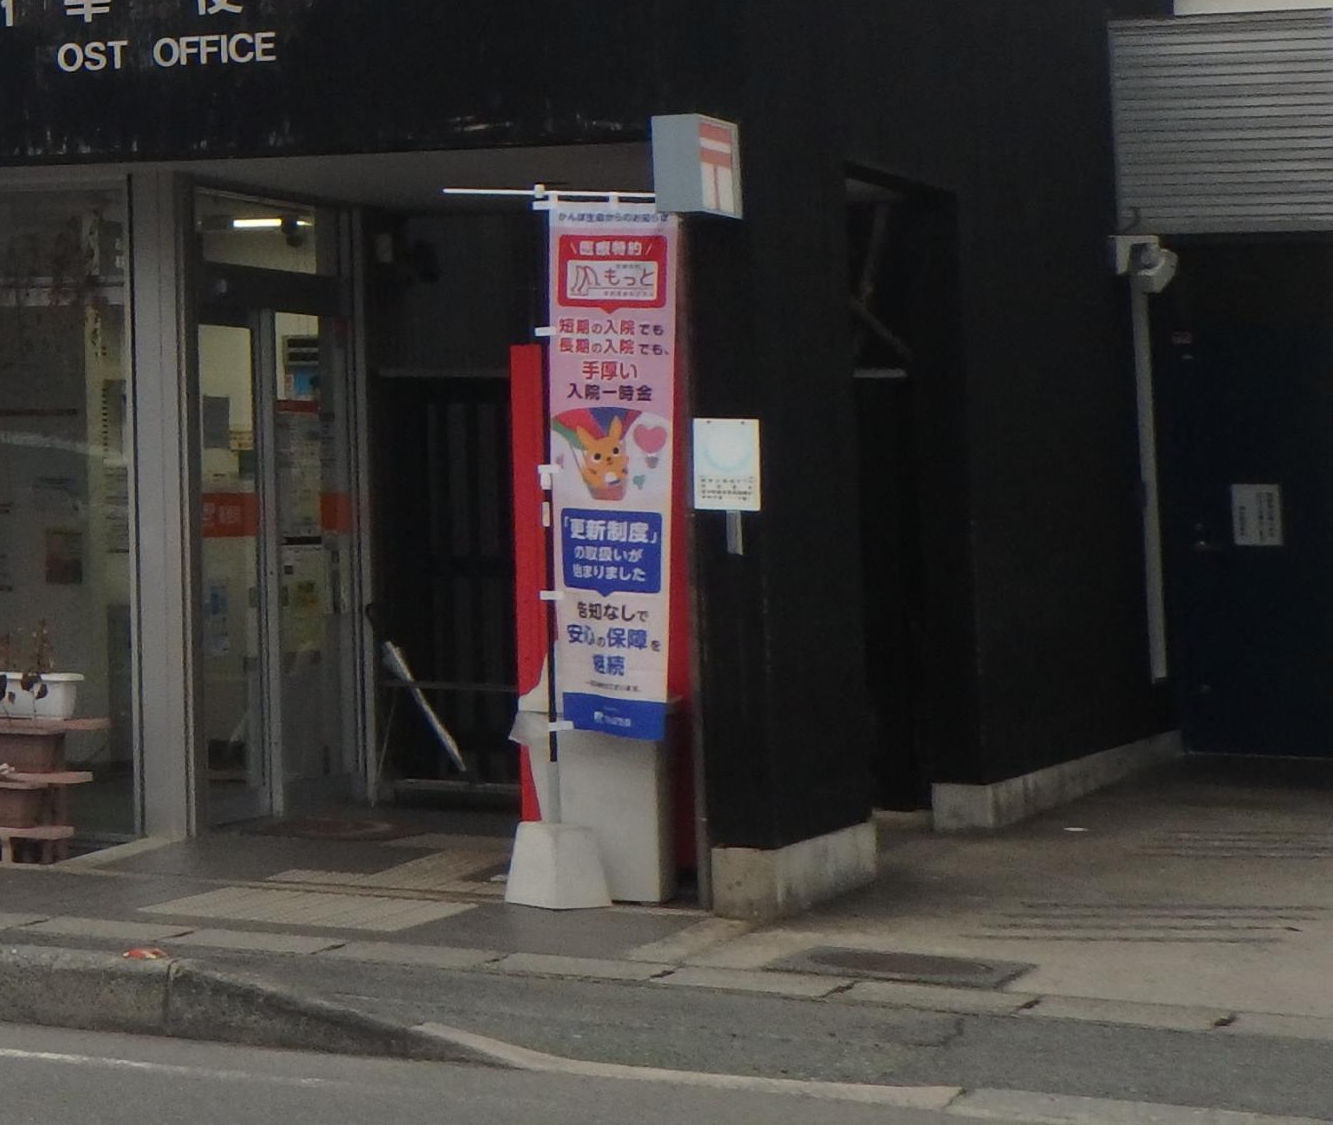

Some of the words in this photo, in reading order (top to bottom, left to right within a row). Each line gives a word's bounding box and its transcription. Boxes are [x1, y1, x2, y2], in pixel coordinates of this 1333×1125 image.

[153, 31, 277, 68] OFFICE
[605, 267, 654, 286] もっと
[582, 360, 638, 381] 手厚い
[567, 382, 652, 402] 入院一時金
[576, 601, 649, 623] 告知なしで
[566, 624, 661, 652] 安心の保障を
